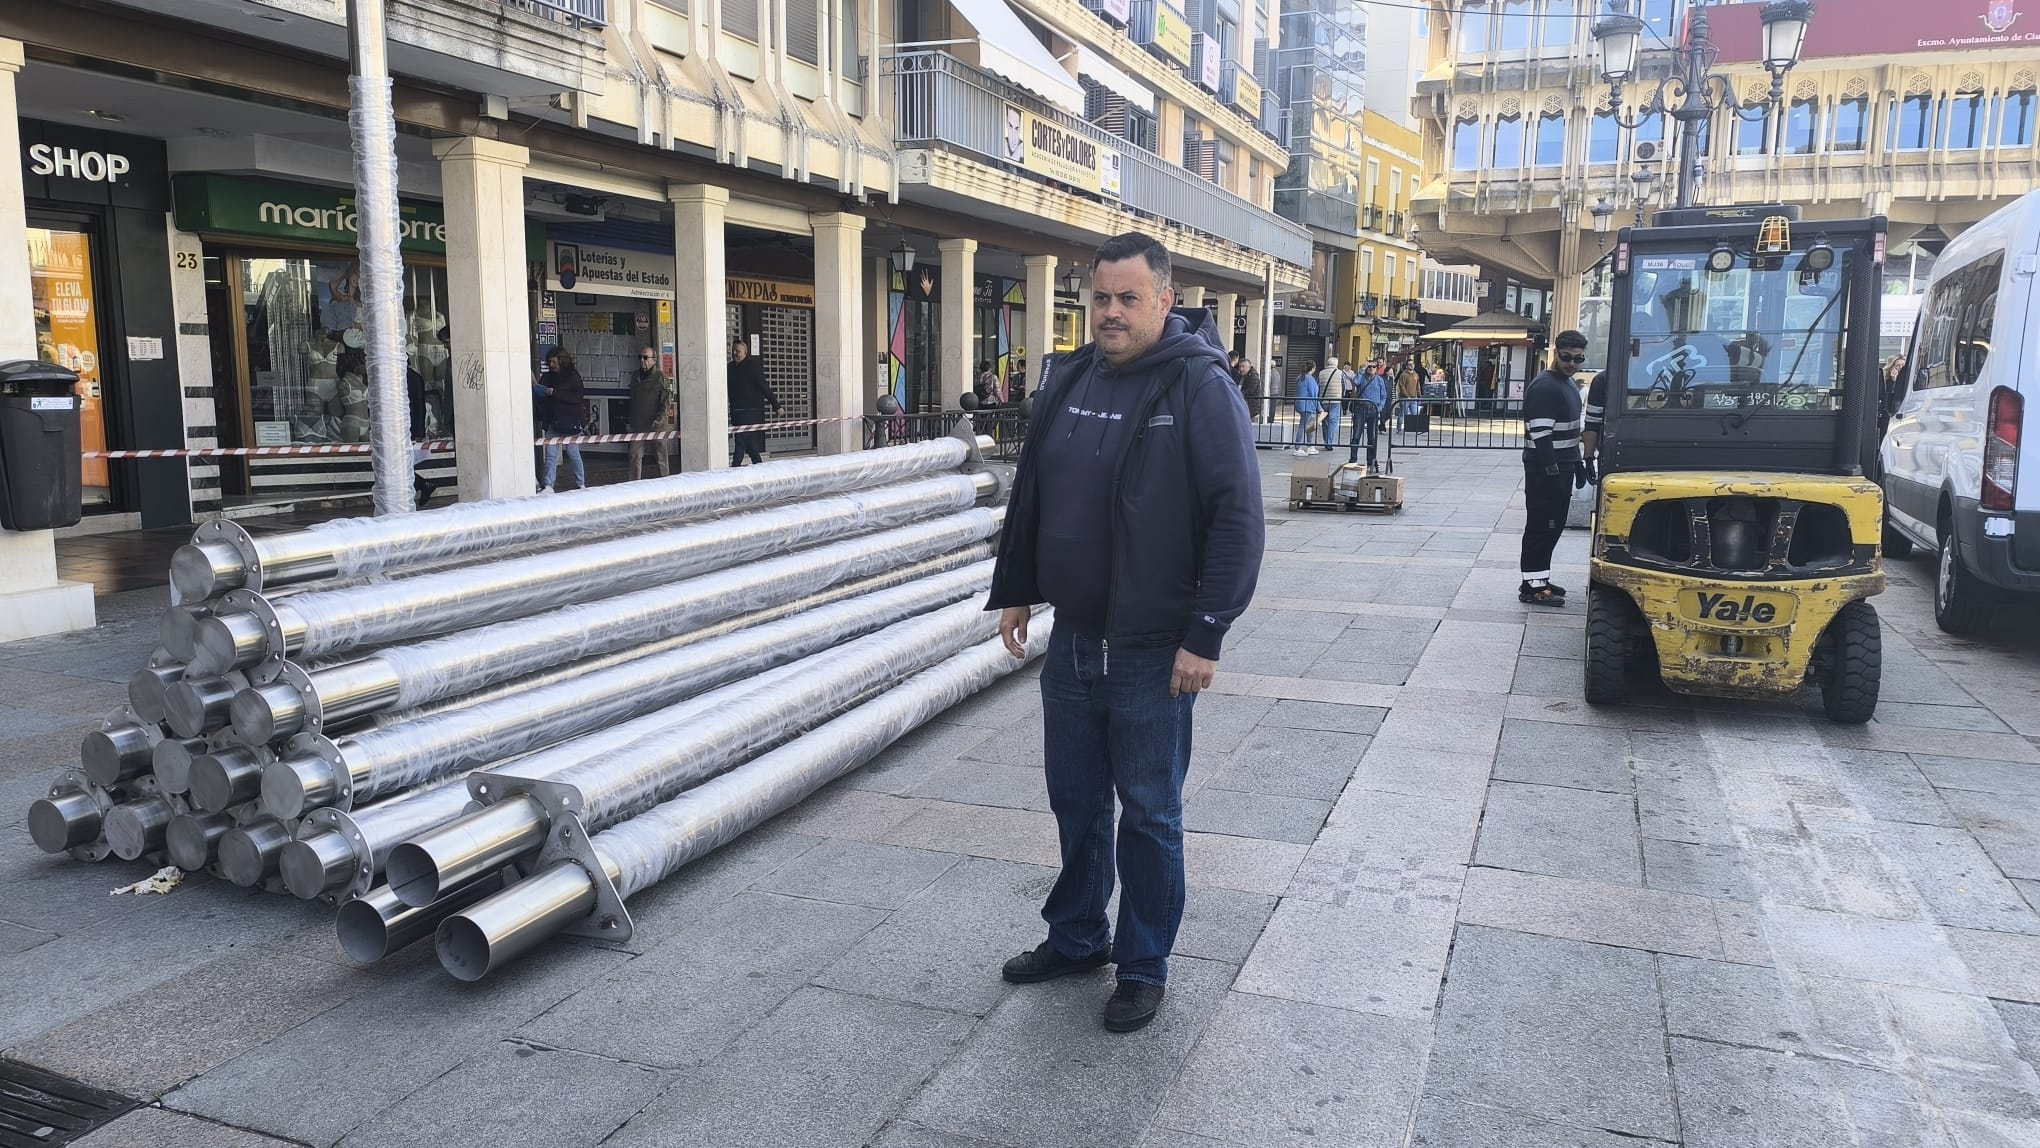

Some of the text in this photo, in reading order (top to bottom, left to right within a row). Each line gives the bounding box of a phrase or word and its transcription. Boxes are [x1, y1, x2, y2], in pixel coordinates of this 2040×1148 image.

[1917, 38, 1946, 47] Excmo.
[1948, 34, 2009, 46] Ayuntamiento
[2011, 33, 2022, 41] de
[29, 143, 130, 183] SHOP
[176, 252, 198, 270] 23
[580, 249, 626, 270] Loterías y
[581, 266, 670, 286] Apuestas del Estado
[55, 281, 82, 297] ELEVA
[63, 298, 89, 313] GLOW
[1068, 406, 1122, 420] TOMMY JEANS
[1697, 591, 1776, 624] Yale
